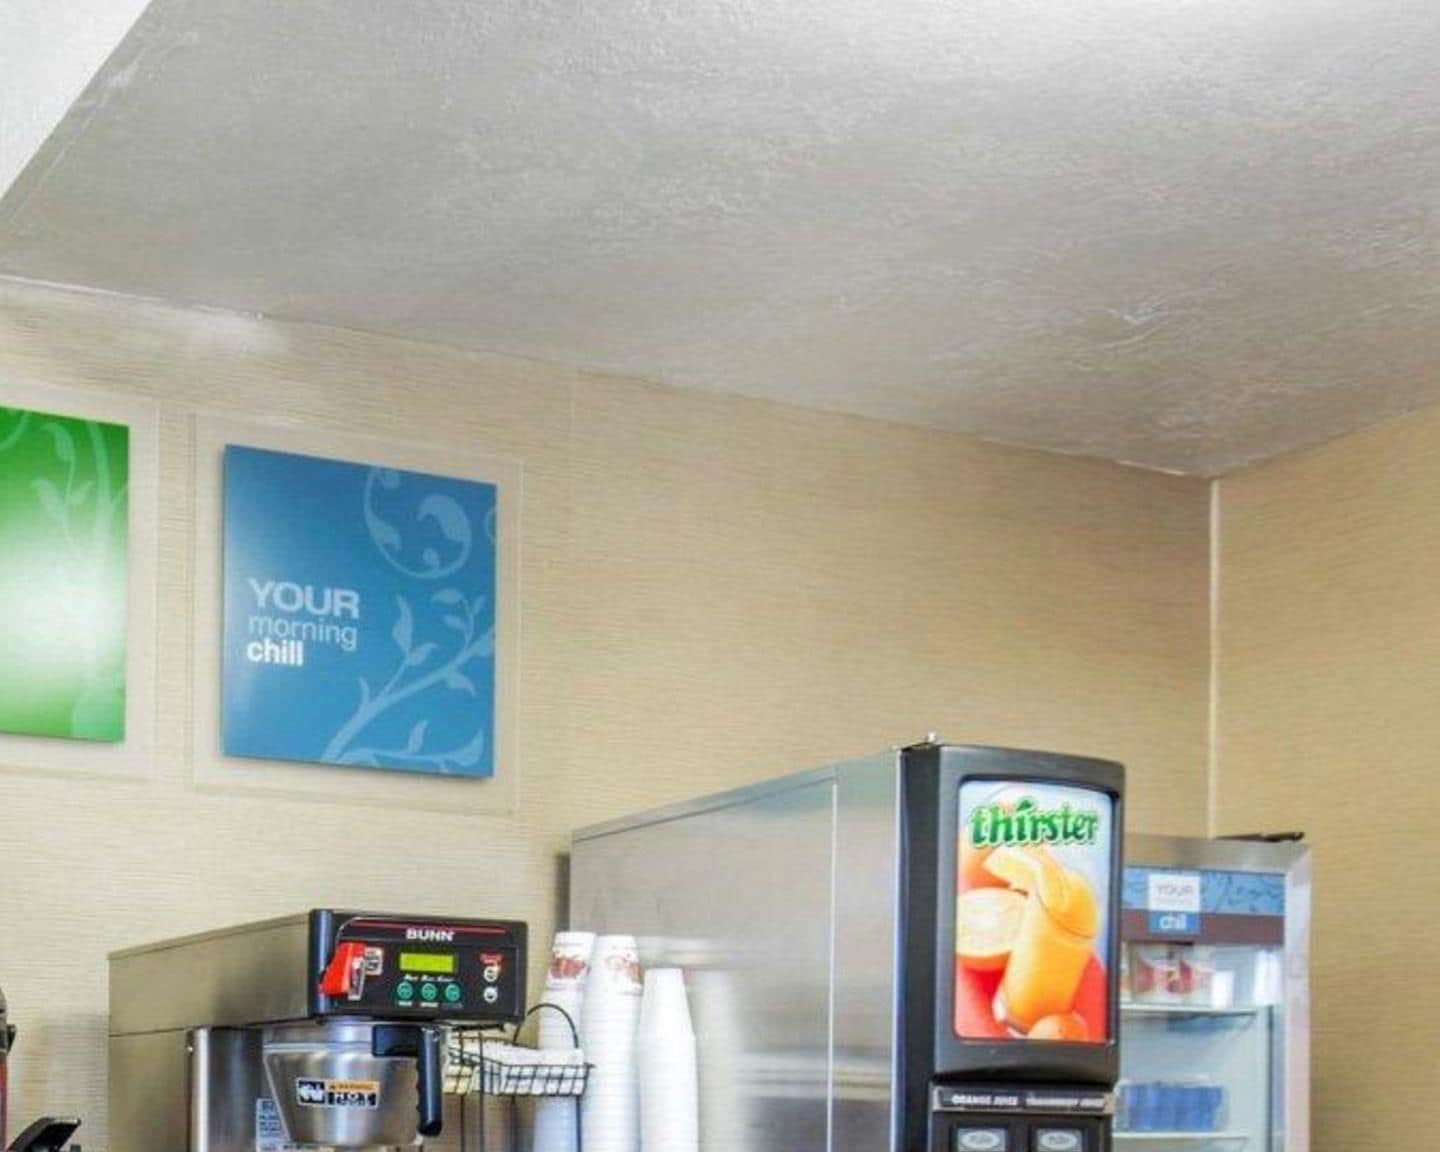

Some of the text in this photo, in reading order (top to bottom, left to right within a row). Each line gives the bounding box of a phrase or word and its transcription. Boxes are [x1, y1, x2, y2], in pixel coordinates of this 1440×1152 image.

[247, 577, 360, 620] YOUR
[247, 637, 304, 667] chill
[248, 615, 358, 652] morning
[970, 800, 1099, 845] thirster
[406, 929, 454, 941] BUNN
